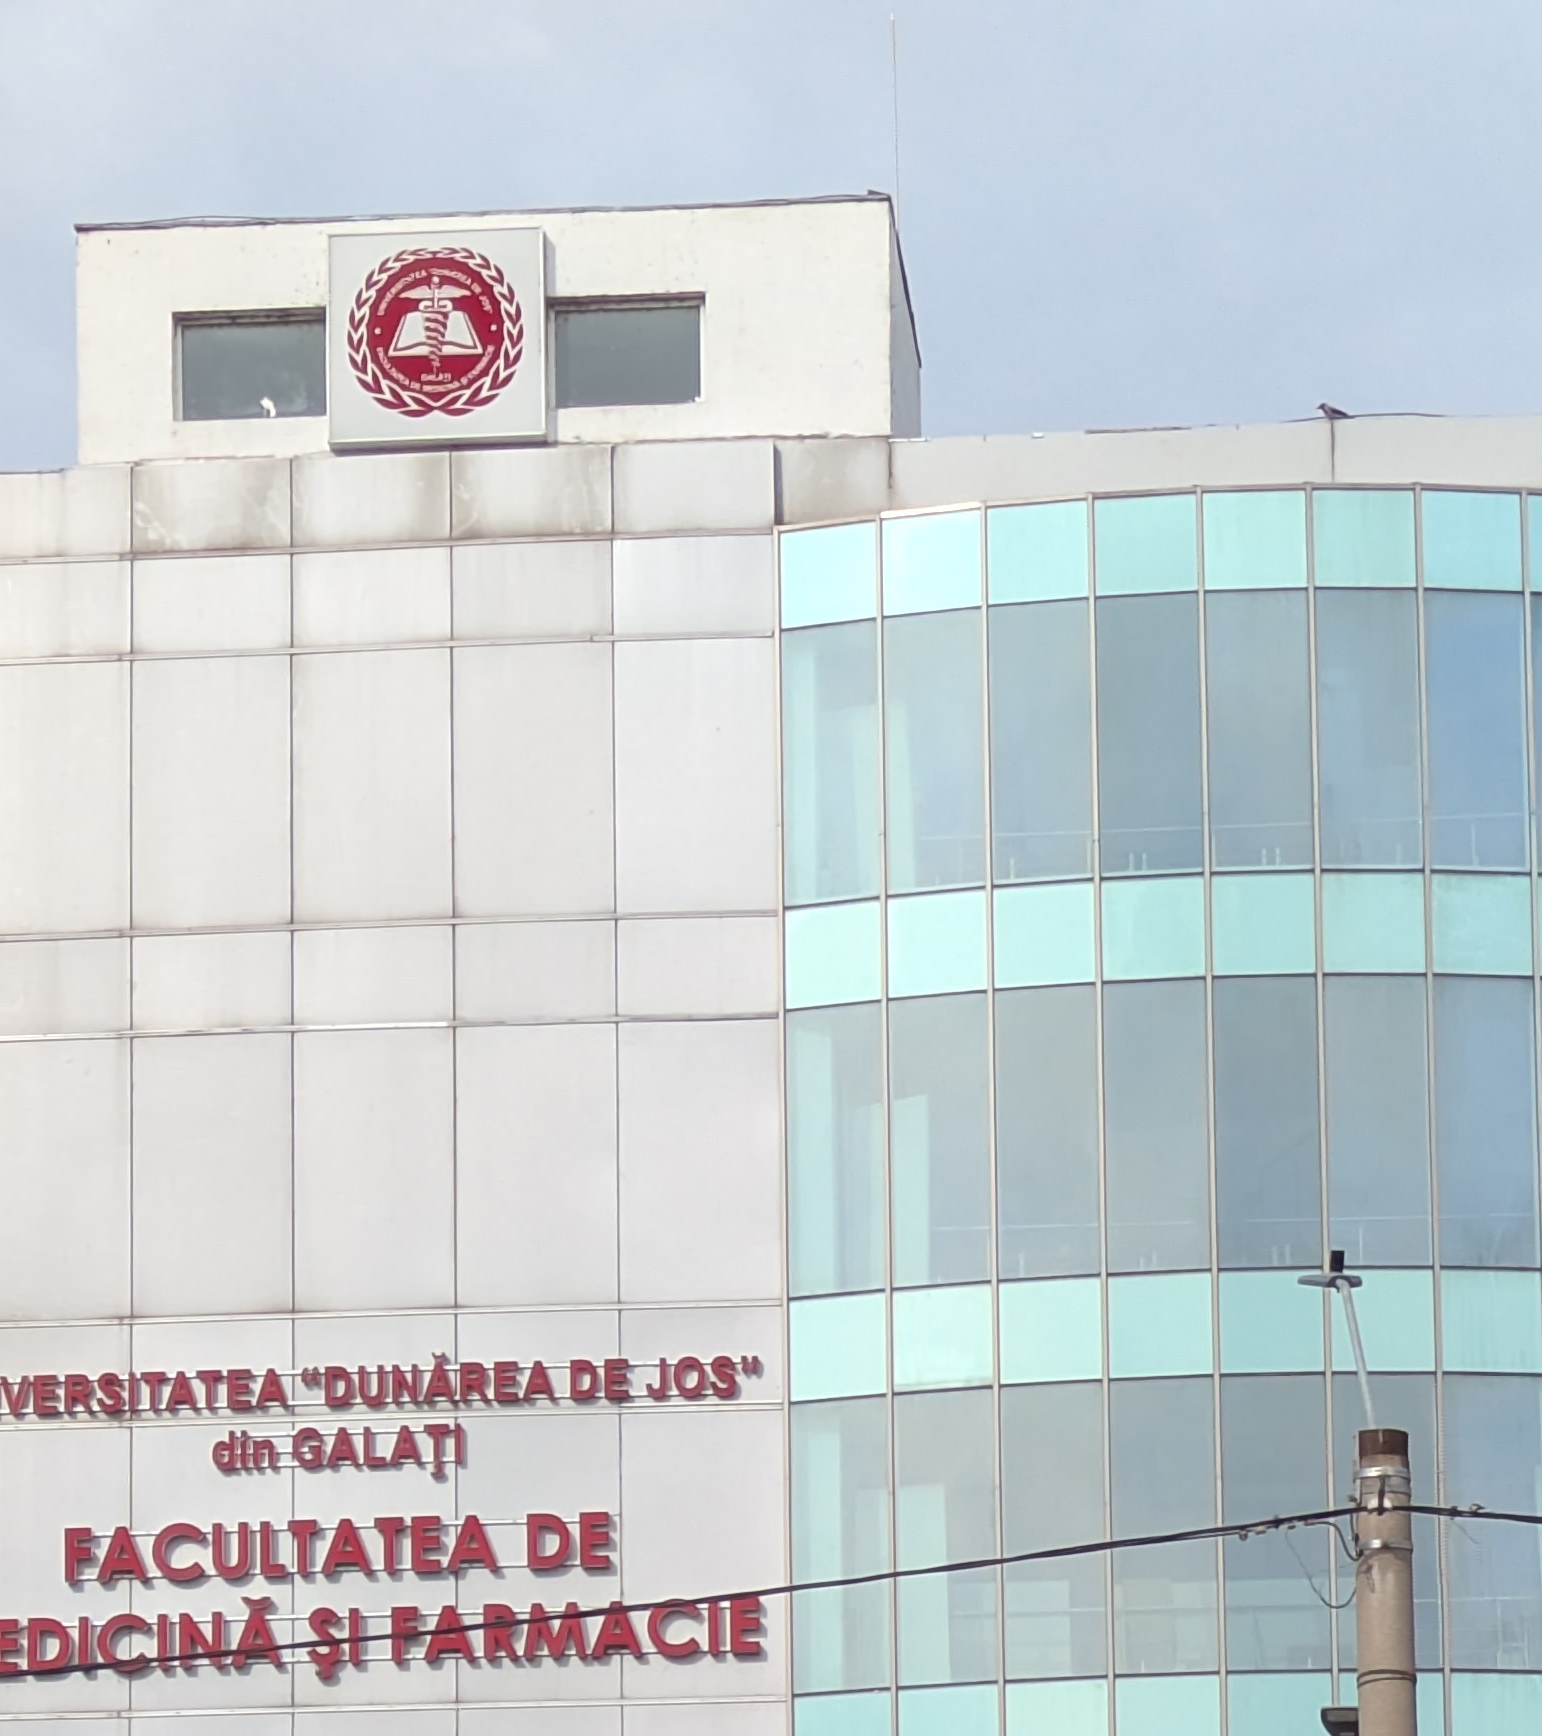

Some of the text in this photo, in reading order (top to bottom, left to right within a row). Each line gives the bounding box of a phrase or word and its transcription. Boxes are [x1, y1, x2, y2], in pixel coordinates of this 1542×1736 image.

[570, 1358, 629, 1400] DE
[212, 1430, 278, 1471] din
[64, 1512, 610, 1584] FACULTATEA DE
[391, 1594, 761, 1664] FARMACIE
